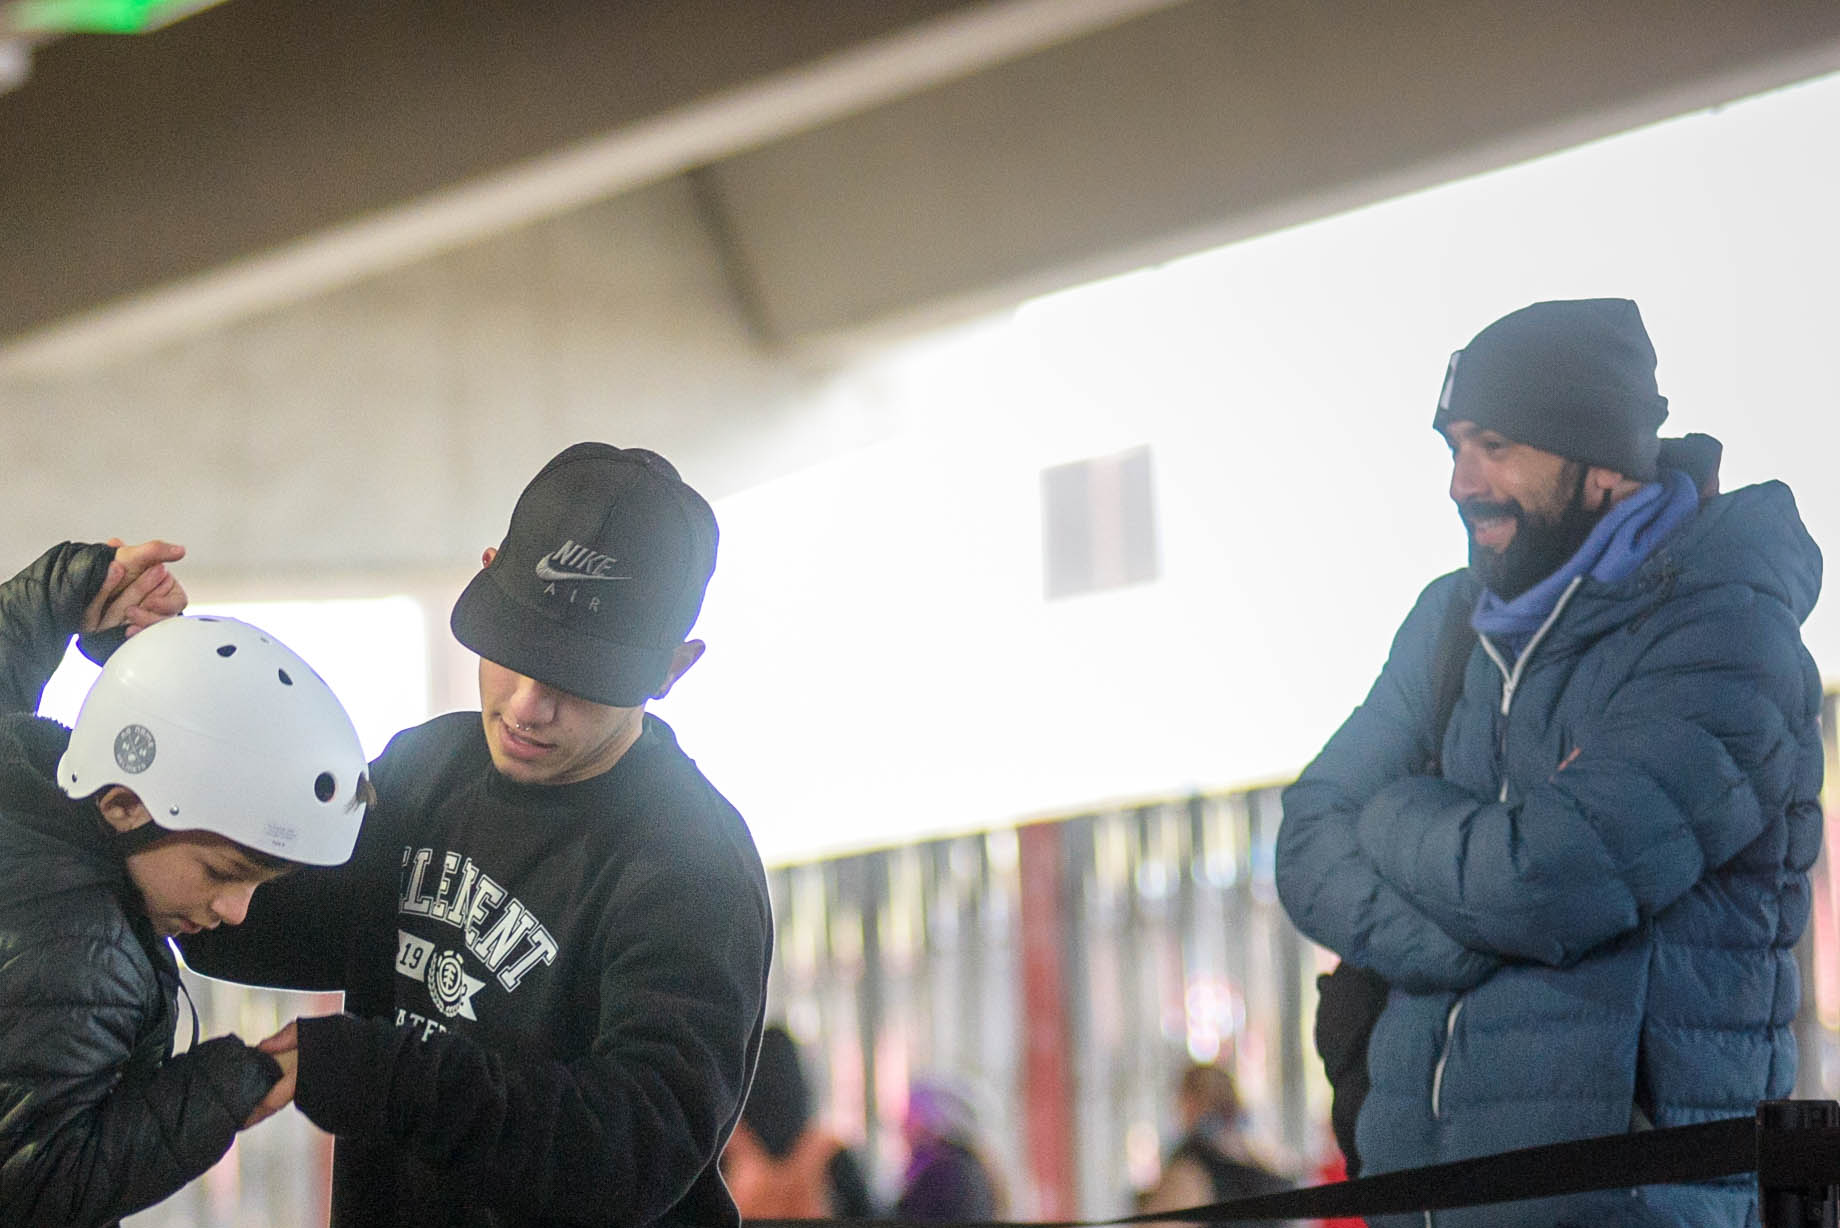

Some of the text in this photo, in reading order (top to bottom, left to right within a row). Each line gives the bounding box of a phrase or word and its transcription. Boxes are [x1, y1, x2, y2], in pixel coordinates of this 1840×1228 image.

[552, 539, 617, 576] NIKE
[543, 581, 601, 613] AIR
[399, 846, 560, 992] LEMENT
[399, 942, 424, 970] 19
